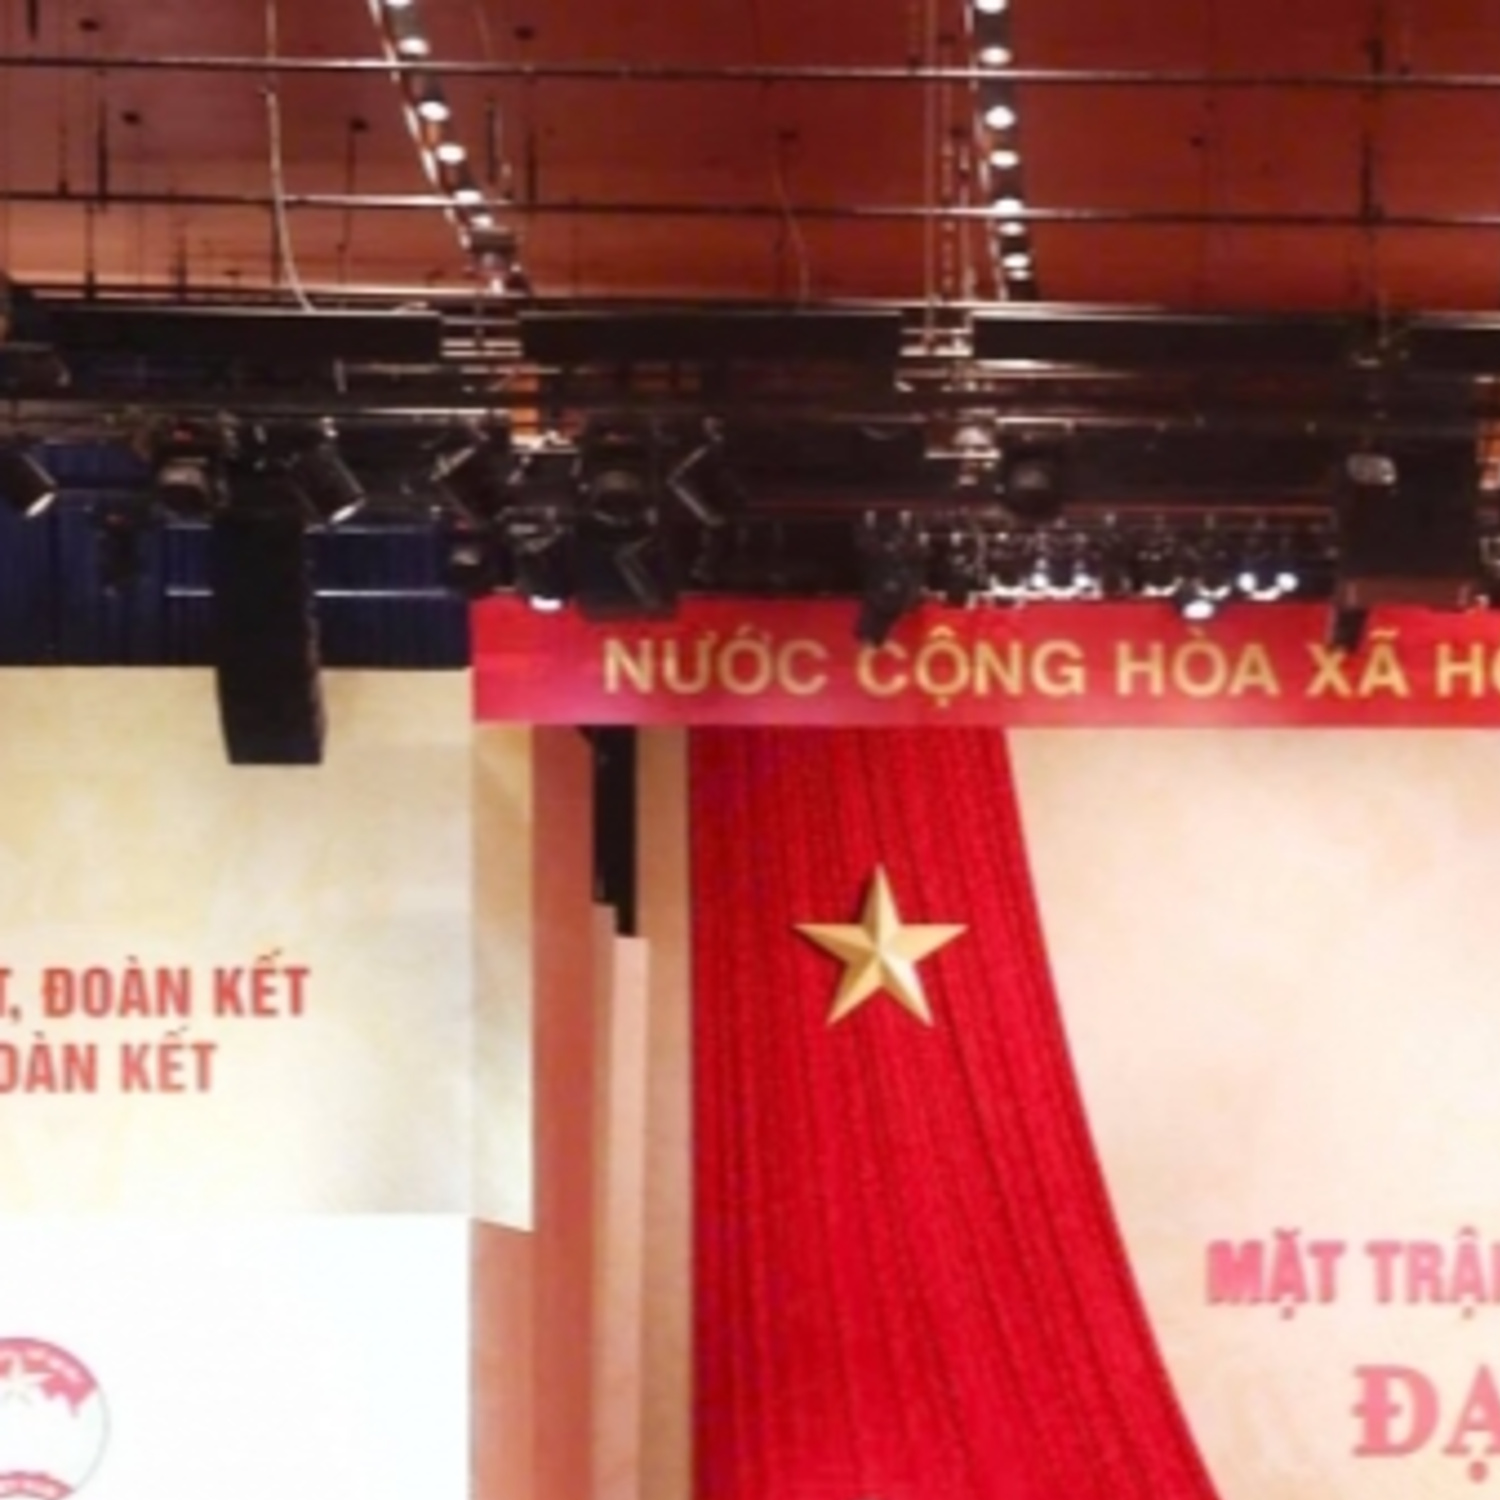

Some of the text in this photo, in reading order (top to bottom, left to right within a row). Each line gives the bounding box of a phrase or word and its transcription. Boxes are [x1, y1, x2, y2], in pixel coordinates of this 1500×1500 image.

[604, 624, 828, 695] NƯỚC
[857, 624, 1085, 709] CỘNG
[1115, 626, 1280, 698] HÒA
[1305, 627, 1411, 698] XÃ
[42, 954, 192, 1018] ĐOÀN
[212, 947, 311, 1018] KẾT
[120, 1025, 217, 1094] KẾT
[1206, 1227, 1347, 1320] MẶT
